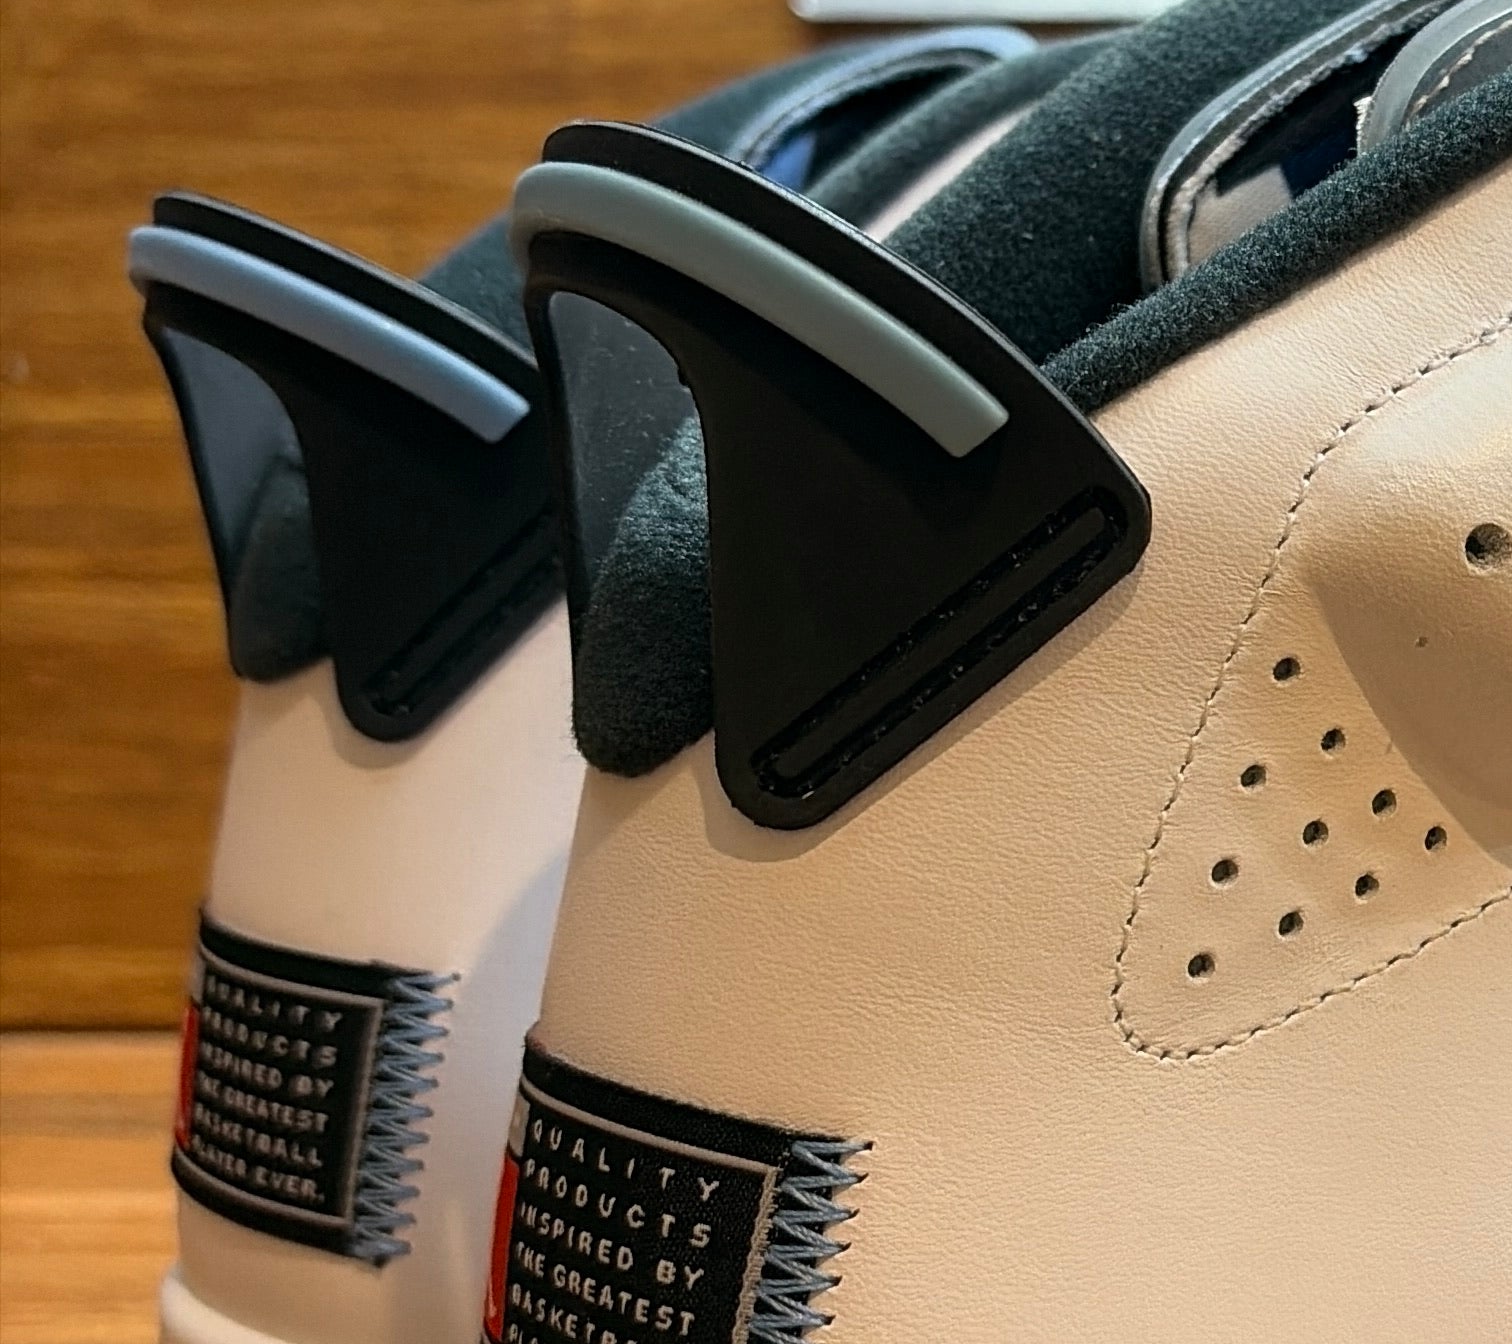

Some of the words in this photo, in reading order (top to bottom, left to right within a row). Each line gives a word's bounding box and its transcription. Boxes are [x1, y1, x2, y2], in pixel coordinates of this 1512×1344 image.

[525, 1158, 711, 1248] PRODUCTS
[533, 1118, 720, 1203] QUALITY
[516, 1241, 546, 1278] THE
[553, 1264, 695, 1336] GREATEST
[520, 1201, 634, 1271] INSPIRED
[656, 1259, 705, 1290] BY
